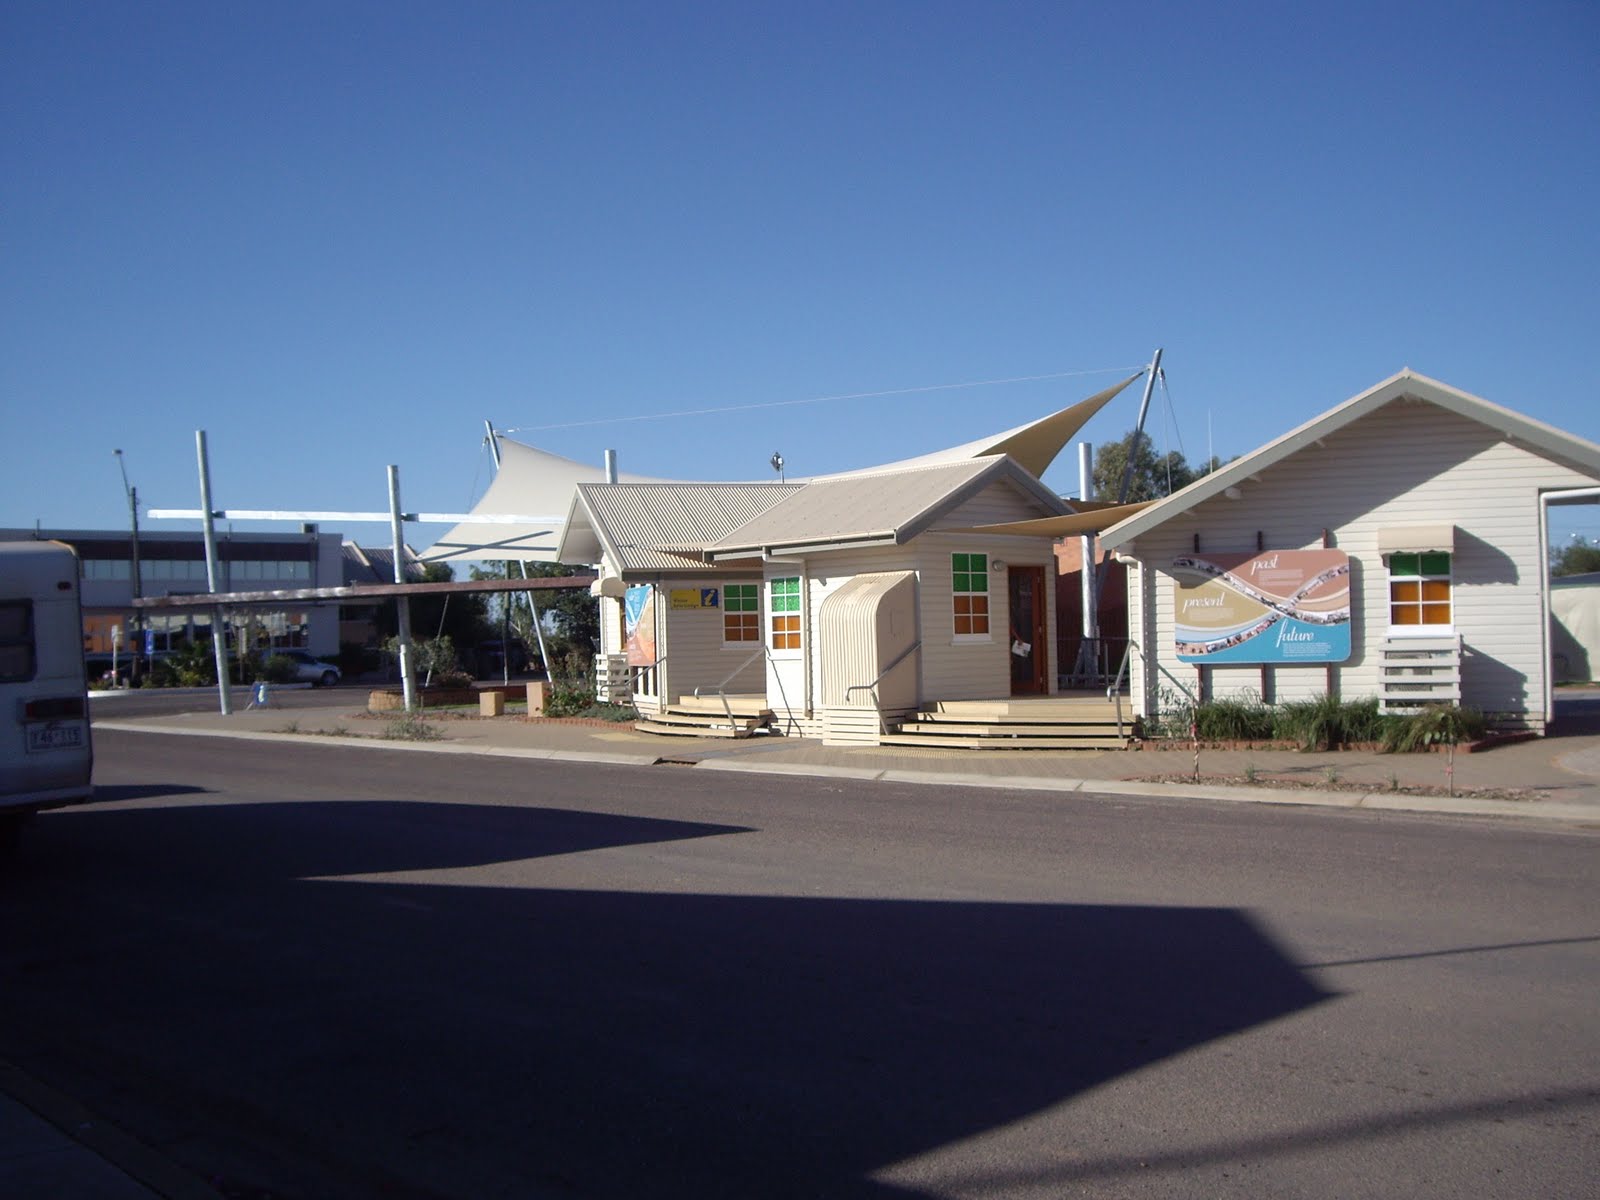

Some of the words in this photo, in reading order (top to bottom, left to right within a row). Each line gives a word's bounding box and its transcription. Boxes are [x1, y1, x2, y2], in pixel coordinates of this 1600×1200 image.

[1251, 554, 1278, 576] past
[1183, 592, 1226, 614] present
[1276, 618, 1314, 648] future
